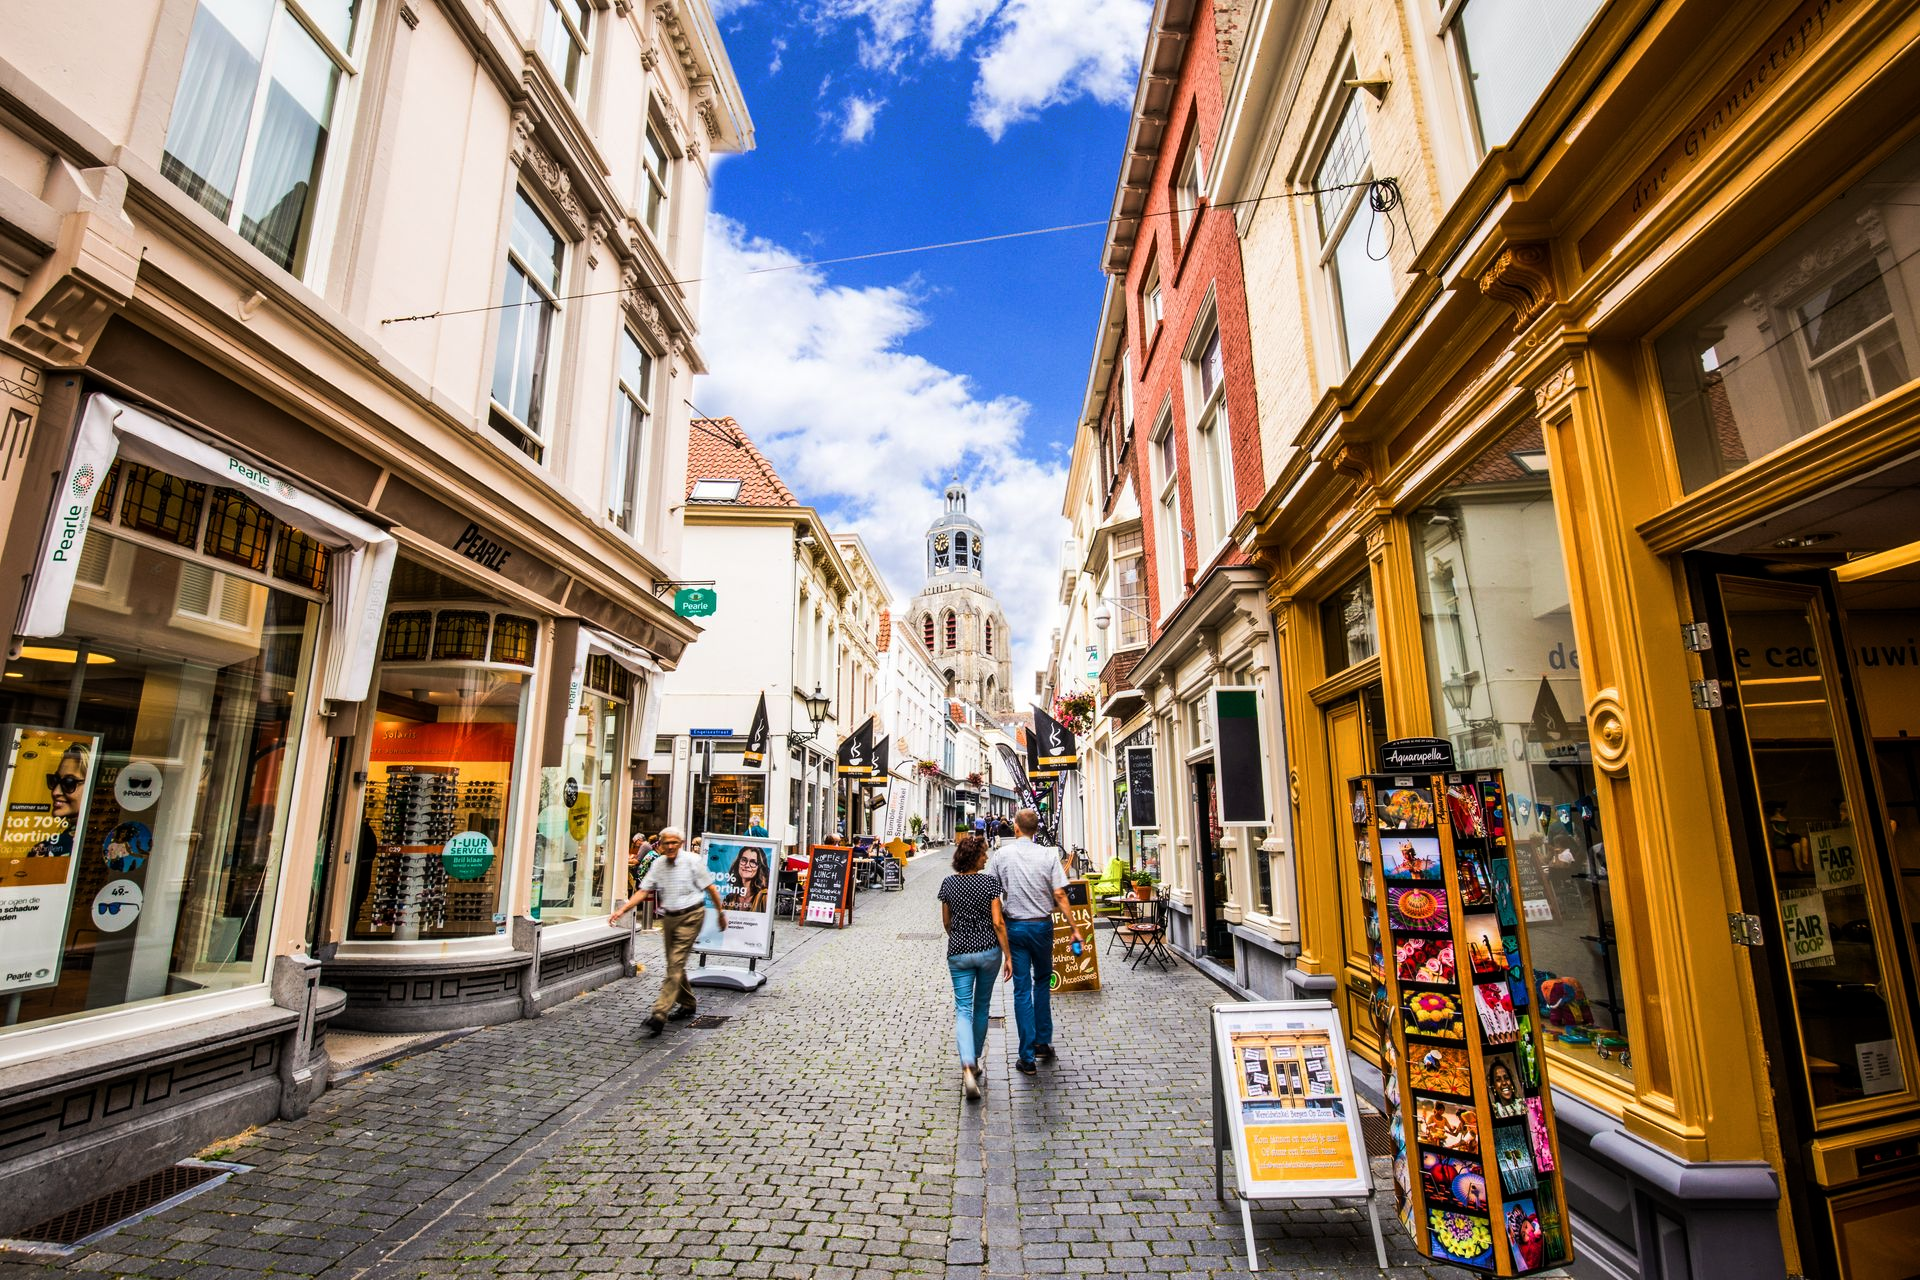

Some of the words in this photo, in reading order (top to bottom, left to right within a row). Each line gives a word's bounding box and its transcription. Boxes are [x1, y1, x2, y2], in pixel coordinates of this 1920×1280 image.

[1632, 167, 1668, 213] drie
[1684, 0, 1843, 162] Granaetapp
[229, 457, 270, 488] Pearle
[53, 505, 82, 562] Pearle
[453, 523, 512, 573] PEARLE
[682, 601, 708, 610] Pearle
[127, 789, 152, 797] Polaroid
[7, 817, 29, 828] tot
[33, 816, 69, 828] 70%
[3, 830, 60, 844] korting
[452, 838, 488, 848] 1-UUR
[1817, 835, 1832, 849] UIT
[1818, 845, 1855, 871] FAIR
[813, 870, 838, 880] LUNCH
[1828, 867, 1856, 884] KOOP
[112, 887, 129, 896] 49.-
[714, 884, 748, 897] orting
[4, 905, 39, 913] schaduw
[1783, 904, 1799, 919] UIT
[1784, 914, 1824, 942] FAIR
[1794, 937, 1825, 956] KOOP
[1052, 955, 1075, 964] lothing
[6, 972, 32, 981] Pearle
[1290, 1109, 1308, 1119] Bergen
[1308, 1109, 1317, 1118] Op
[1317, 1108, 1332, 1117] Zoom
